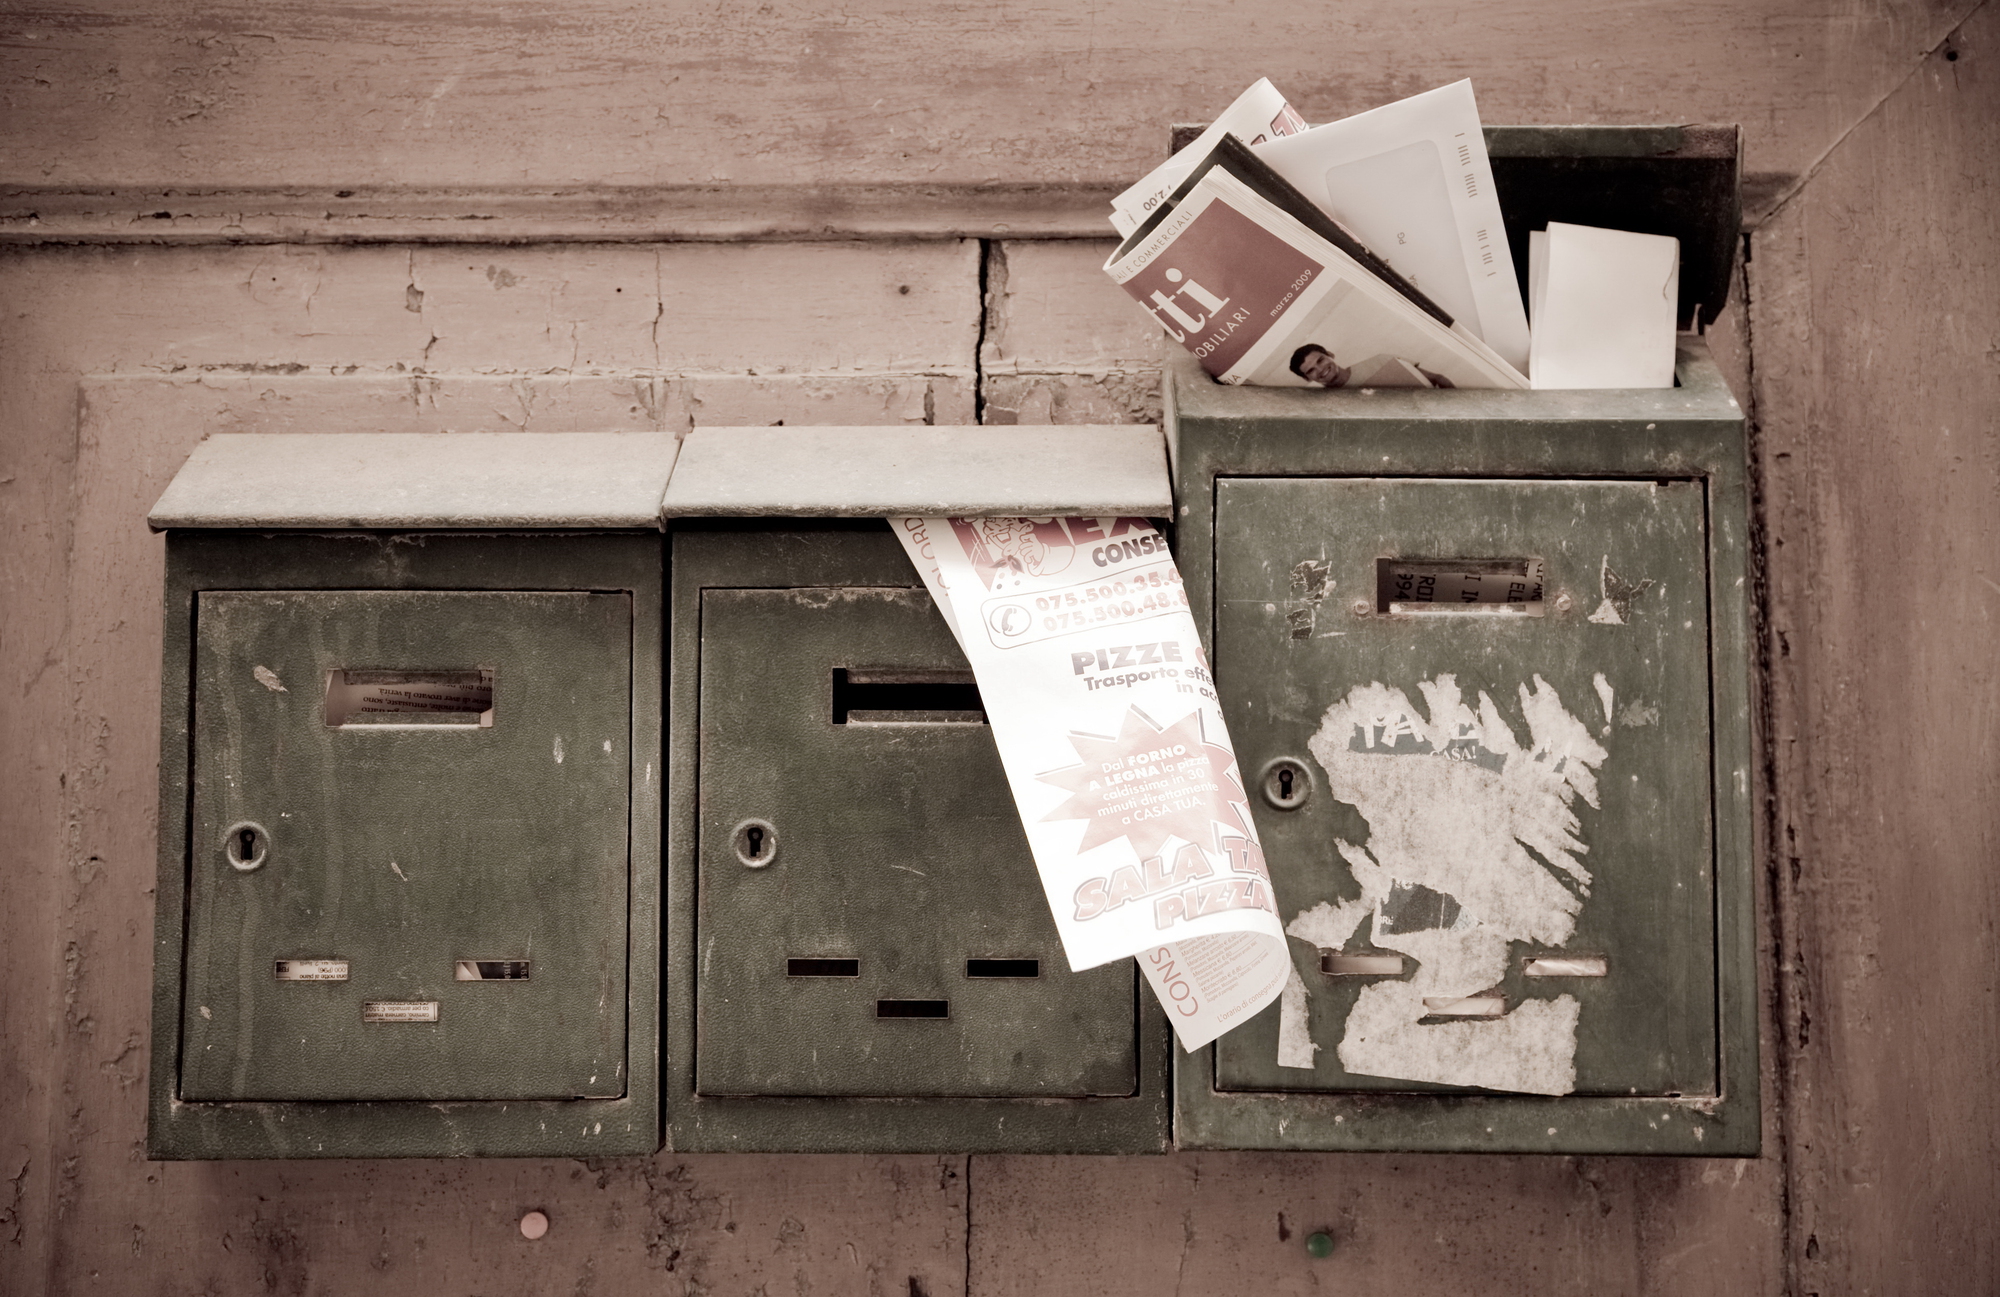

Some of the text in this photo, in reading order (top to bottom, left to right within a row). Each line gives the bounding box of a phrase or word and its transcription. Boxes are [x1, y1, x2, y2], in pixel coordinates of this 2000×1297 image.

[1132, 210, 1193, 268] COMMERCIALI
[1396, 231, 1406, 245] PG
[1269, 268, 1313, 317] marzo 2009
[1071, 641, 1183, 676] PIZZE
[1083, 666, 1179, 691] Trasporto
[1176, 681, 1194, 696] in
[1088, 756, 1210, 792] A LEGNA la pizza
[1101, 743, 1187, 774] Dal FORNO
[1097, 781, 1219, 818] minuti direttamente
[1102, 767, 1205, 802] caldissima in 30
[1121, 795, 1206, 825] a CASA TUA.
[1073, 842, 1214, 922] SALA
[1153, 877, 1273, 931] PIZZA
[1217, 1004, 1242, 1022] L'orario
